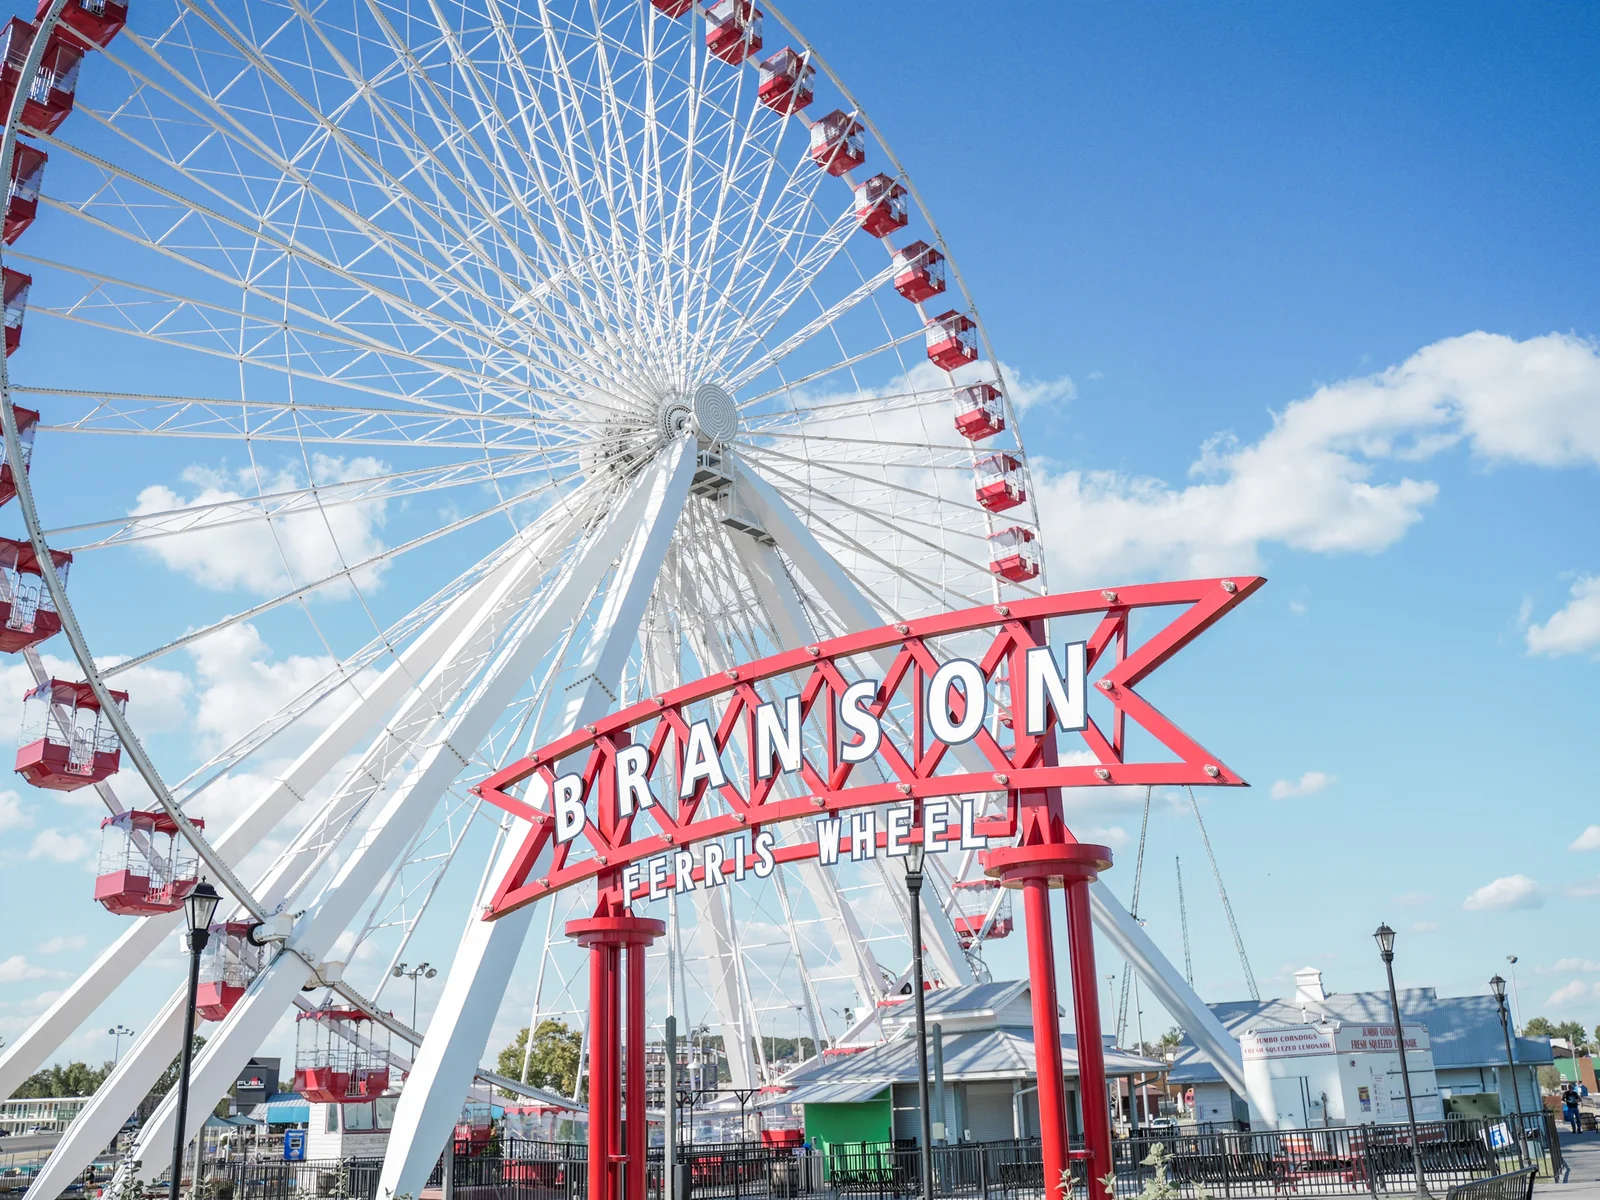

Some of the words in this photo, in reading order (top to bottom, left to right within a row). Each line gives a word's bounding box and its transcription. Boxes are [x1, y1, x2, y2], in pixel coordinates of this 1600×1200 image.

[553, 640, 1088, 845] BRANSON
[622, 830, 775, 909] FERRIS
[816, 799, 988, 868] WHEEL
[1362, 1027, 1379, 1037] JUMBO
[1380, 1027, 1405, 1037] CORNDS
[1256, 1036, 1278, 1044] JUMBO
[1280, 1034, 1318, 1043] CORNDOGS
[1351, 1040, 1368, 1049] FRESH
[1369, 1039, 1393, 1050] SQUEEZED
[1394, 1038, 1418, 1048] LONADE
[1244, 1047, 1264, 1055] FRESH
[1266, 1045, 1297, 1054] SQUEEZED
[1299, 1042, 1331, 1051] LEMONADE
